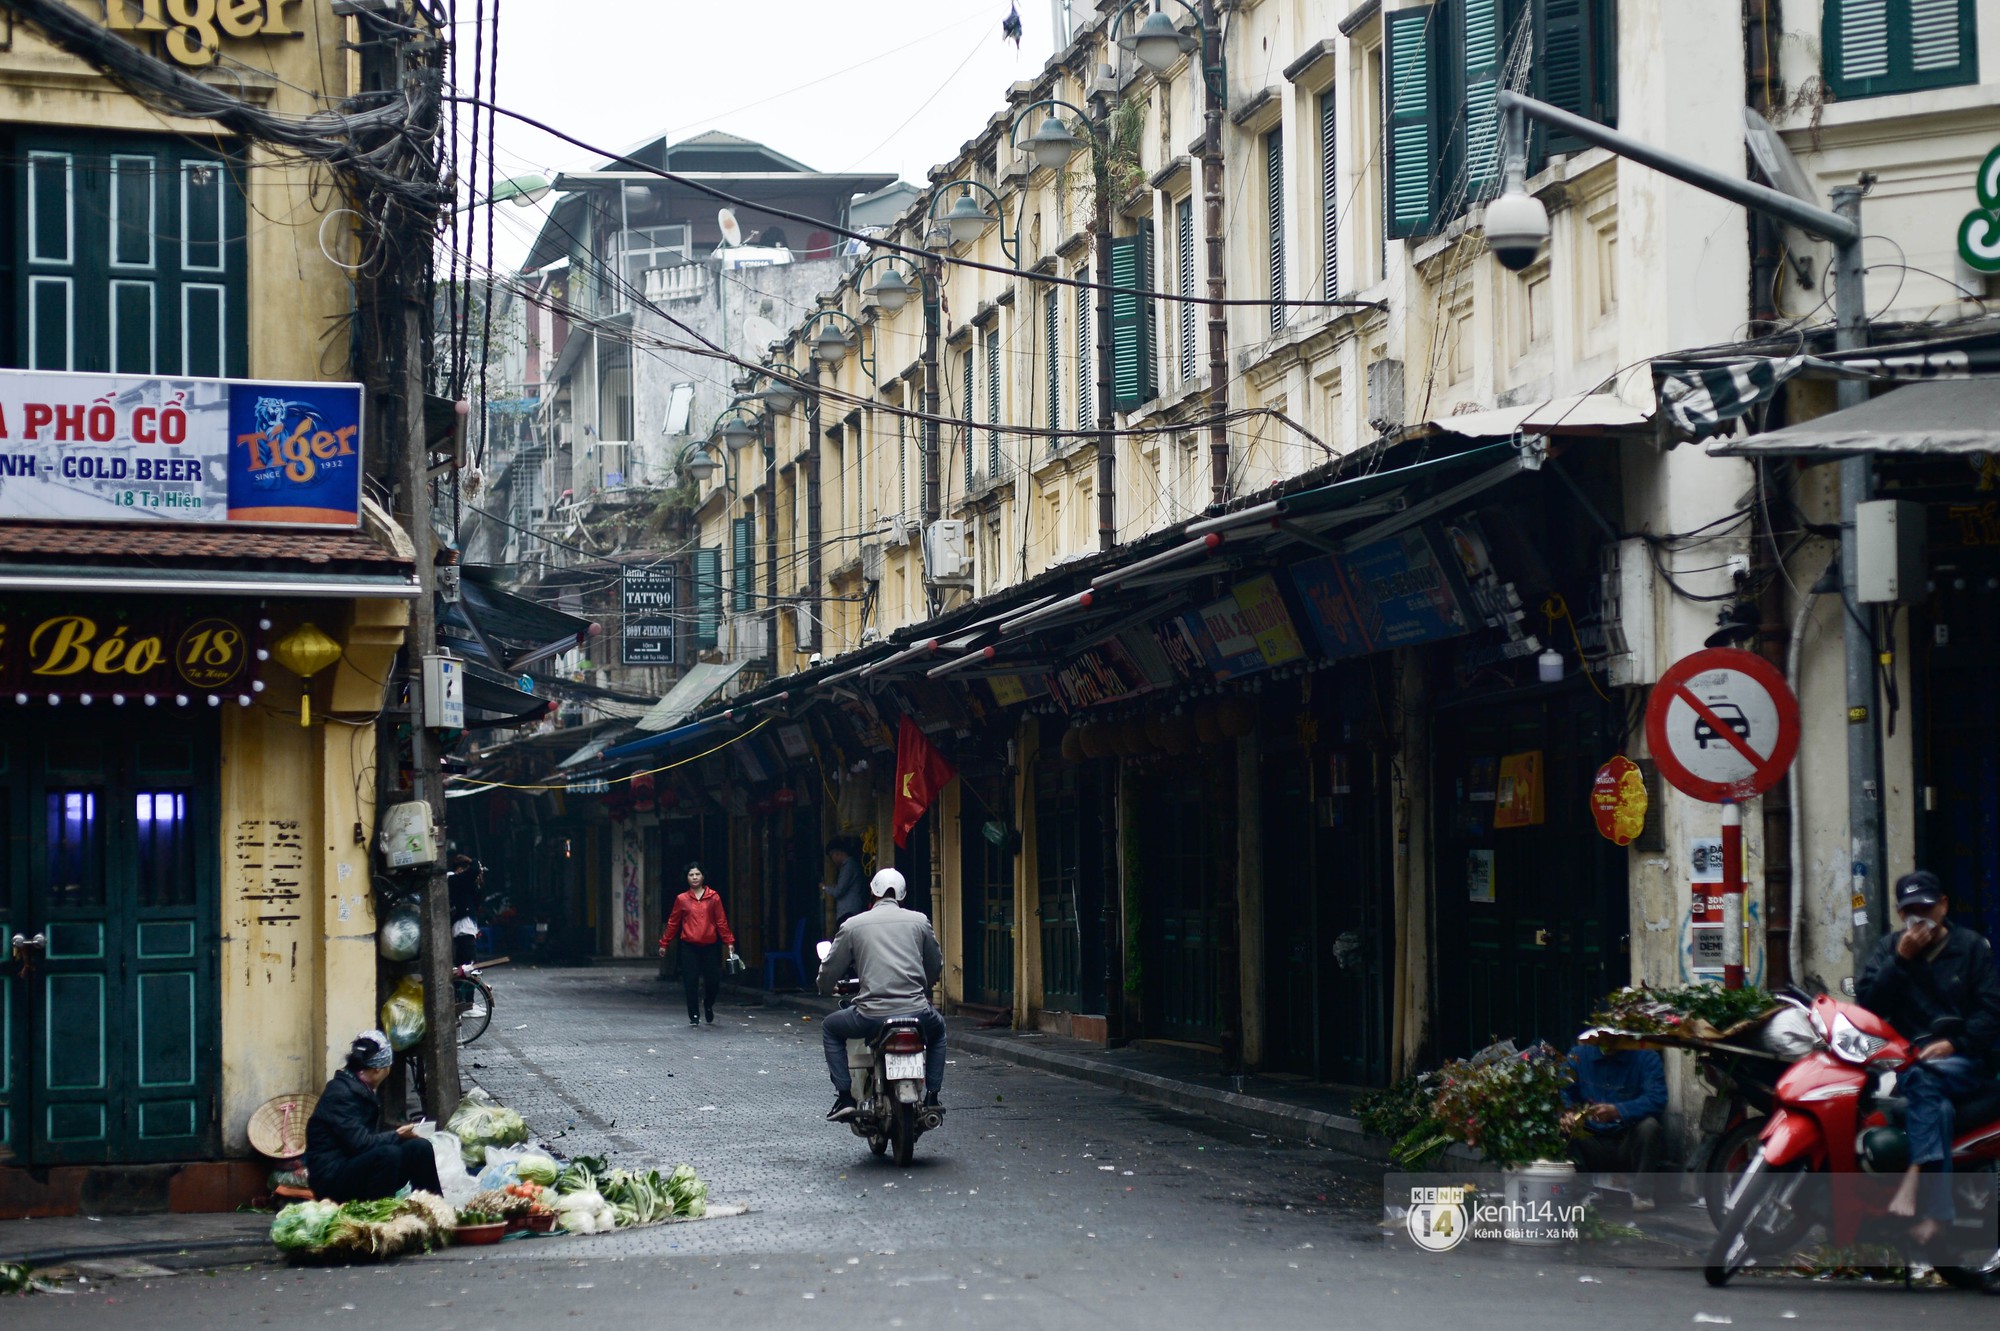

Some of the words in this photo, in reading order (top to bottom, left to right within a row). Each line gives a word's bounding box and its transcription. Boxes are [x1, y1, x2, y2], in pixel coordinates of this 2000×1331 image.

[23, 391, 117, 442] PHỐ
[132, 391, 187, 444] CỔ
[236, 418, 357, 482] Tiger
[320, 459, 343, 469] 1932
[62, 456, 127, 480] COLD
[135, 458, 202, 481] BEER
[255, 470, 280, 481] SINCE
[114, 491, 134, 507] 18
[139, 491, 159, 510] Tạ
[164, 491, 202, 510] Hiện
[29, 616, 166, 675] Béo
[185, 628, 238, 665] 18
